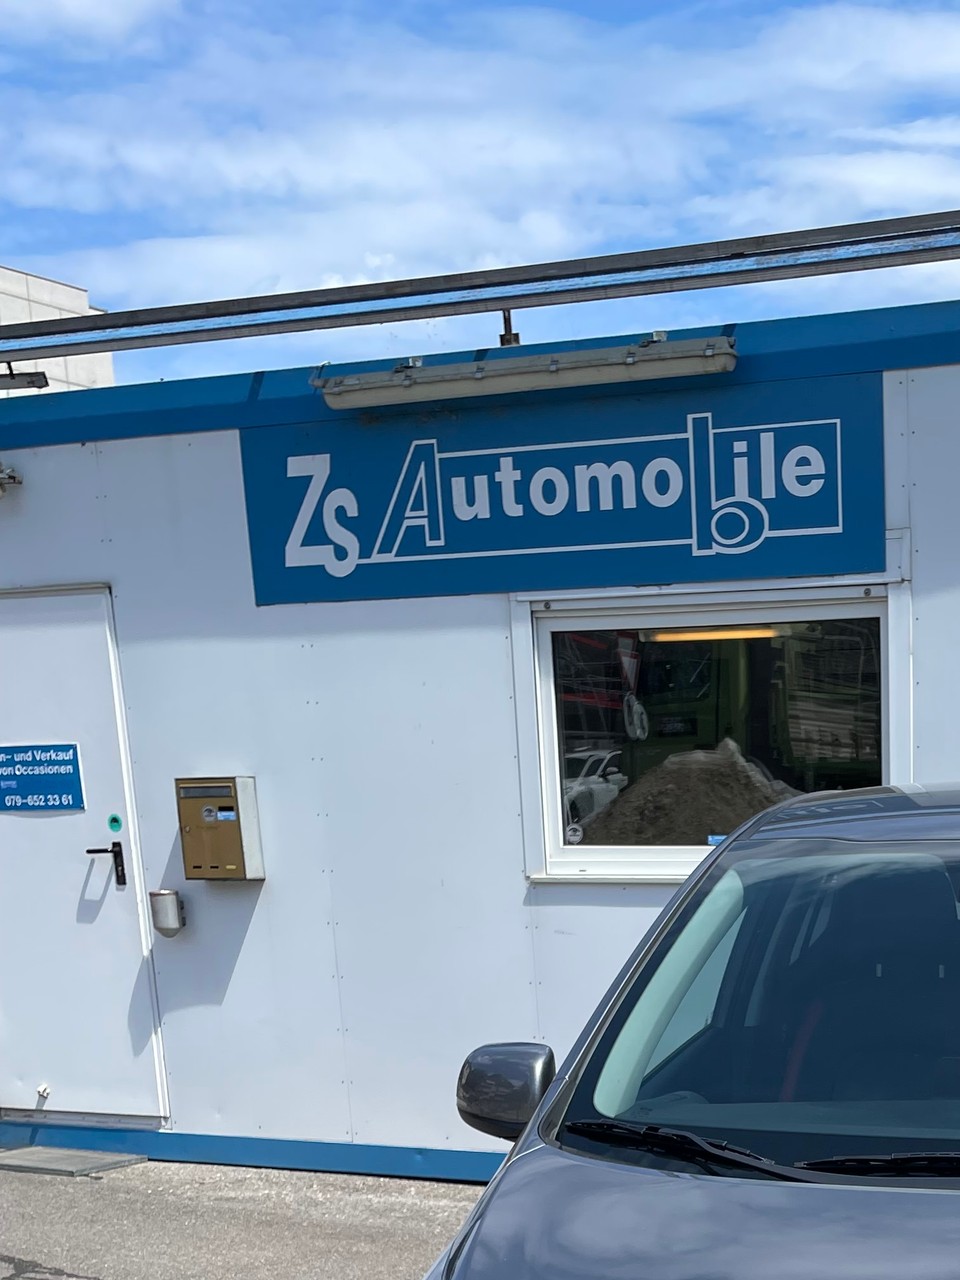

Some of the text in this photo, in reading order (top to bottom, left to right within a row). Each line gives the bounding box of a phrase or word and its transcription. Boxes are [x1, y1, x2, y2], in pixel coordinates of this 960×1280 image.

[371, 412, 828, 559] Automobile
[14, 750, 32, 761] und
[33, 749, 73, 761] Verkauf
[15, 763, 73, 775] Occasionen
[47, 794, 61, 806] 33
[61, 793, 73, 806] 61
